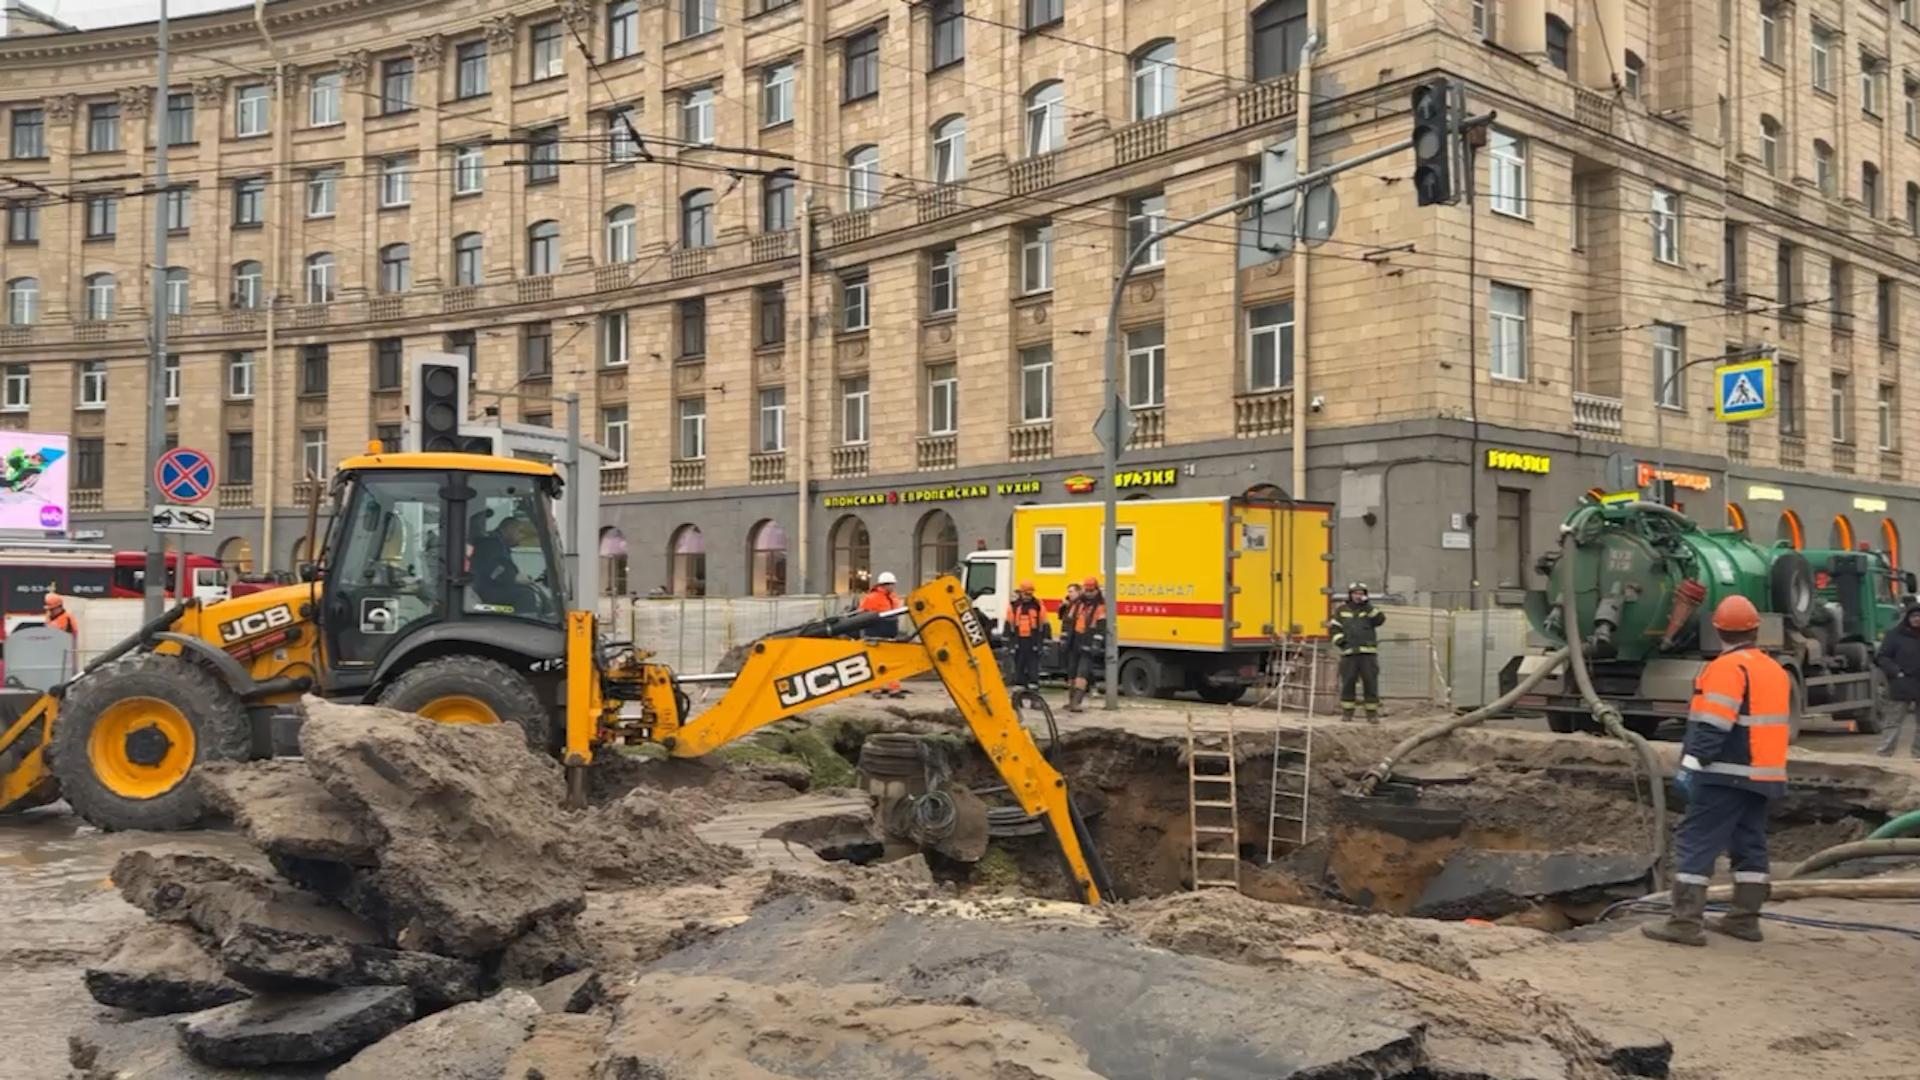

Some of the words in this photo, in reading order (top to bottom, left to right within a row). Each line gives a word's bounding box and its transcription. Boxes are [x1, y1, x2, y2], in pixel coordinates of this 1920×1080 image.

[1113, 468, 1176, 488] ВРАЗИЯ
[823, 493, 885, 508] ЯПОНСКАЯ
[900, 484, 988, 503] ЕВРОПЕЙСКАЯ
[996, 480, 1041, 496] КУХНЯ
[1117, 582, 1195, 597] ОДОКАНАЛ
[1123, 604, 1168, 614] СЛУЖБА
[222, 605, 293, 642] JCB
[780, 655, 872, 705] JCB
